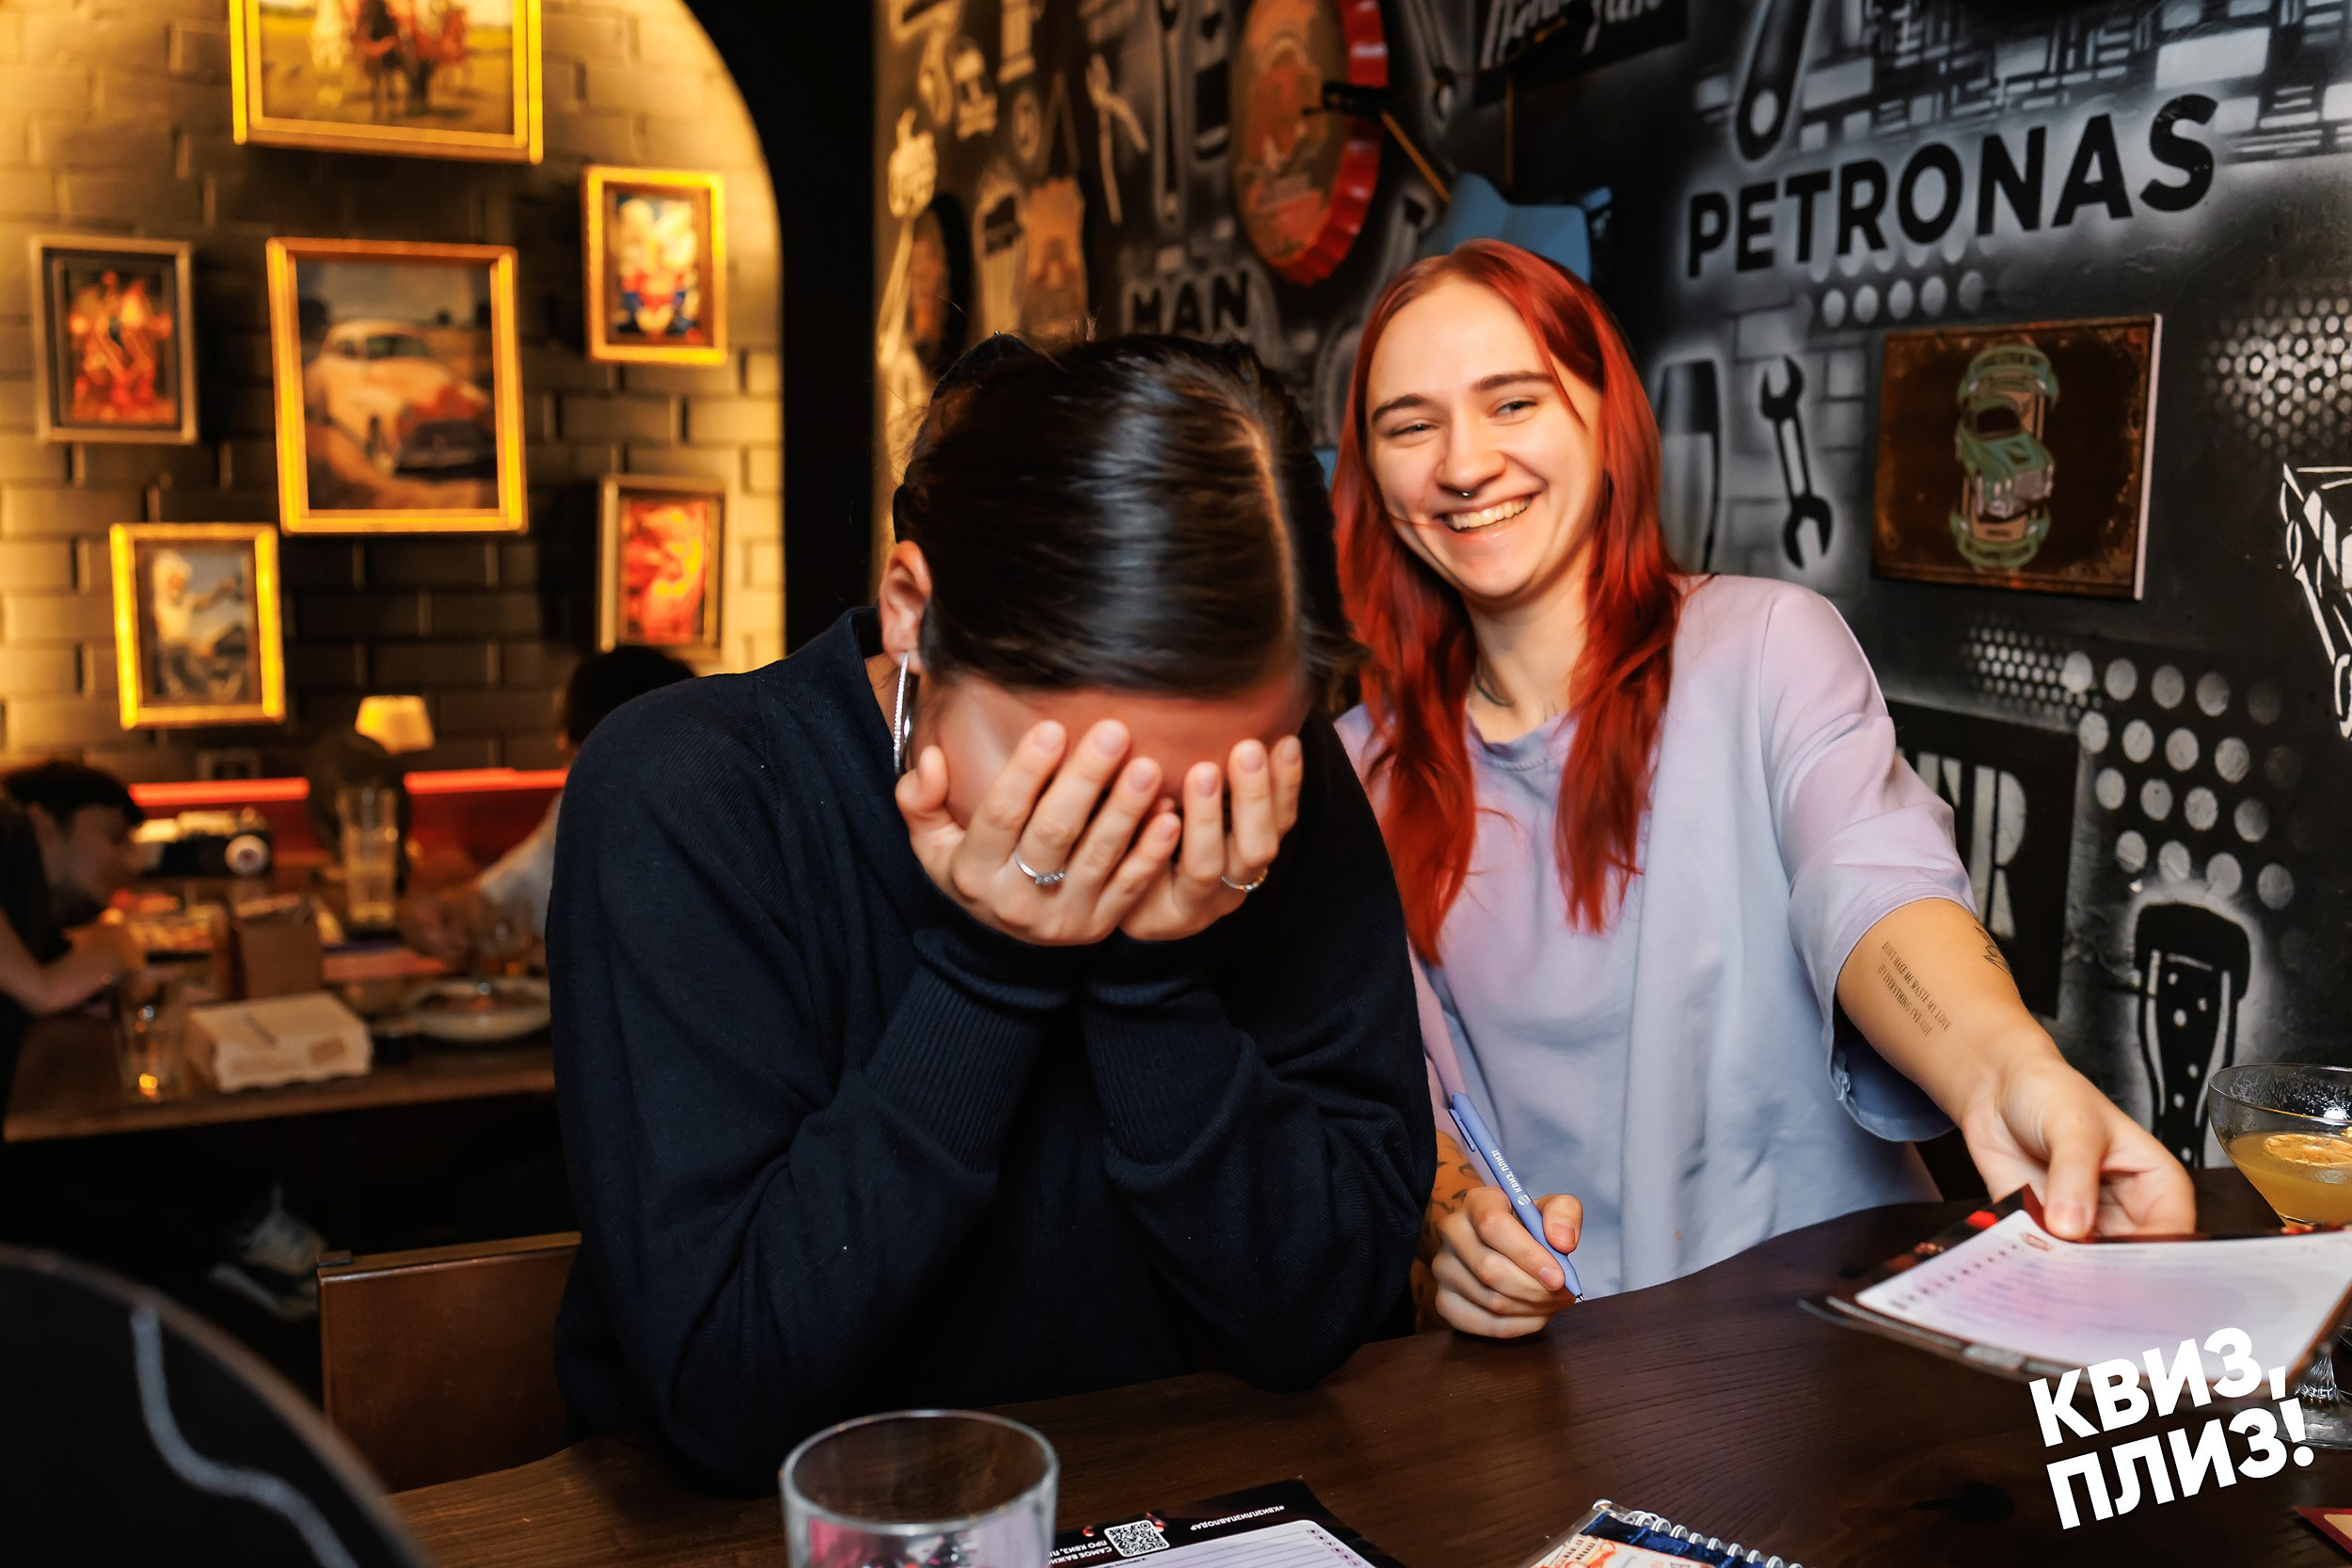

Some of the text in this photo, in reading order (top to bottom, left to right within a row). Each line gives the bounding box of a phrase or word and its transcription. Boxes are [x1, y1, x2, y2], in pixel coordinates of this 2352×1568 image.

[1688, 93, 2218, 278] PETRONAS
[1133, 269, 1249, 334] MAN
[1883, 972, 1914, 1012] EVERYTHING
[1919, 1019, 1933, 1037] GOT
[1894, 956, 1908, 974] MAKE
[1903, 971, 1915, 985] ME
[1910, 980, 1930, 1003] WASTE
[1927, 999, 1938, 1014] MY
[1934, 1009, 1952, 1031] LOVE
[1491, 1149, 1523, 1194] КВИЗ, ПЛИЗ!
[1189, 1505, 1285, 1531] #КВИЗПЛИЗПАВЛОДАР
[1059, 1544, 1088, 1555] КВИЗ,
[1077, 1546, 1113, 1559] САМОЕ
[1087, 1540, 1108, 1549] ПРО
